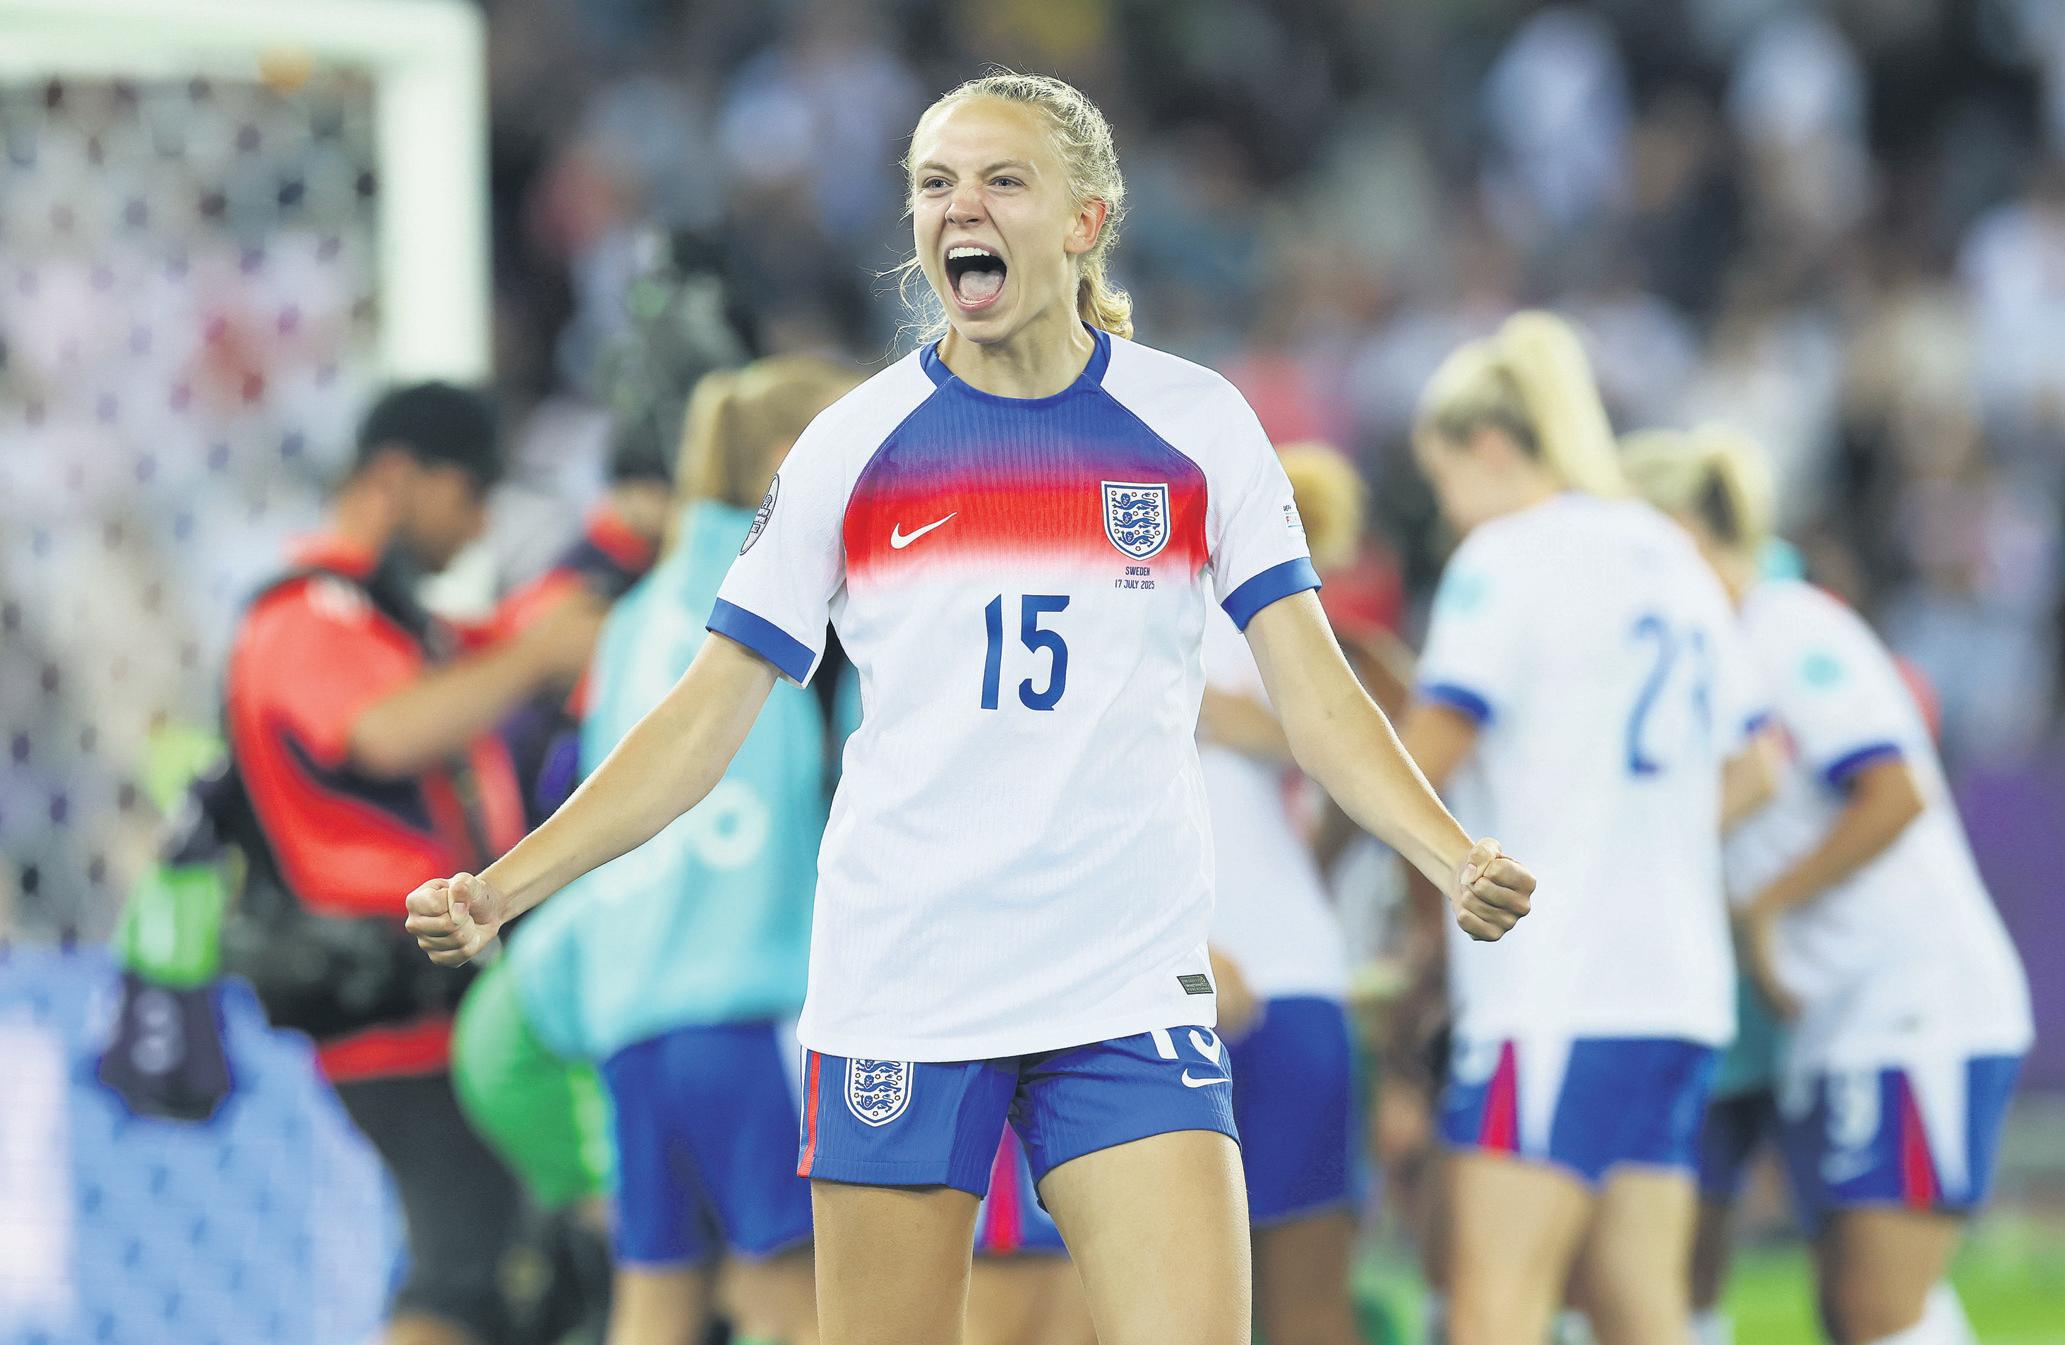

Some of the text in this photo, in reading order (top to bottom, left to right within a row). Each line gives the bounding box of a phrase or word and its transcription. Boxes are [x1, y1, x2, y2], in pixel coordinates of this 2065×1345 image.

[1125, 566, 1151, 576] SWEDEN
[1114, 579, 1155, 590] 17 JULY 2025
[980, 593, 1070, 711] 15
